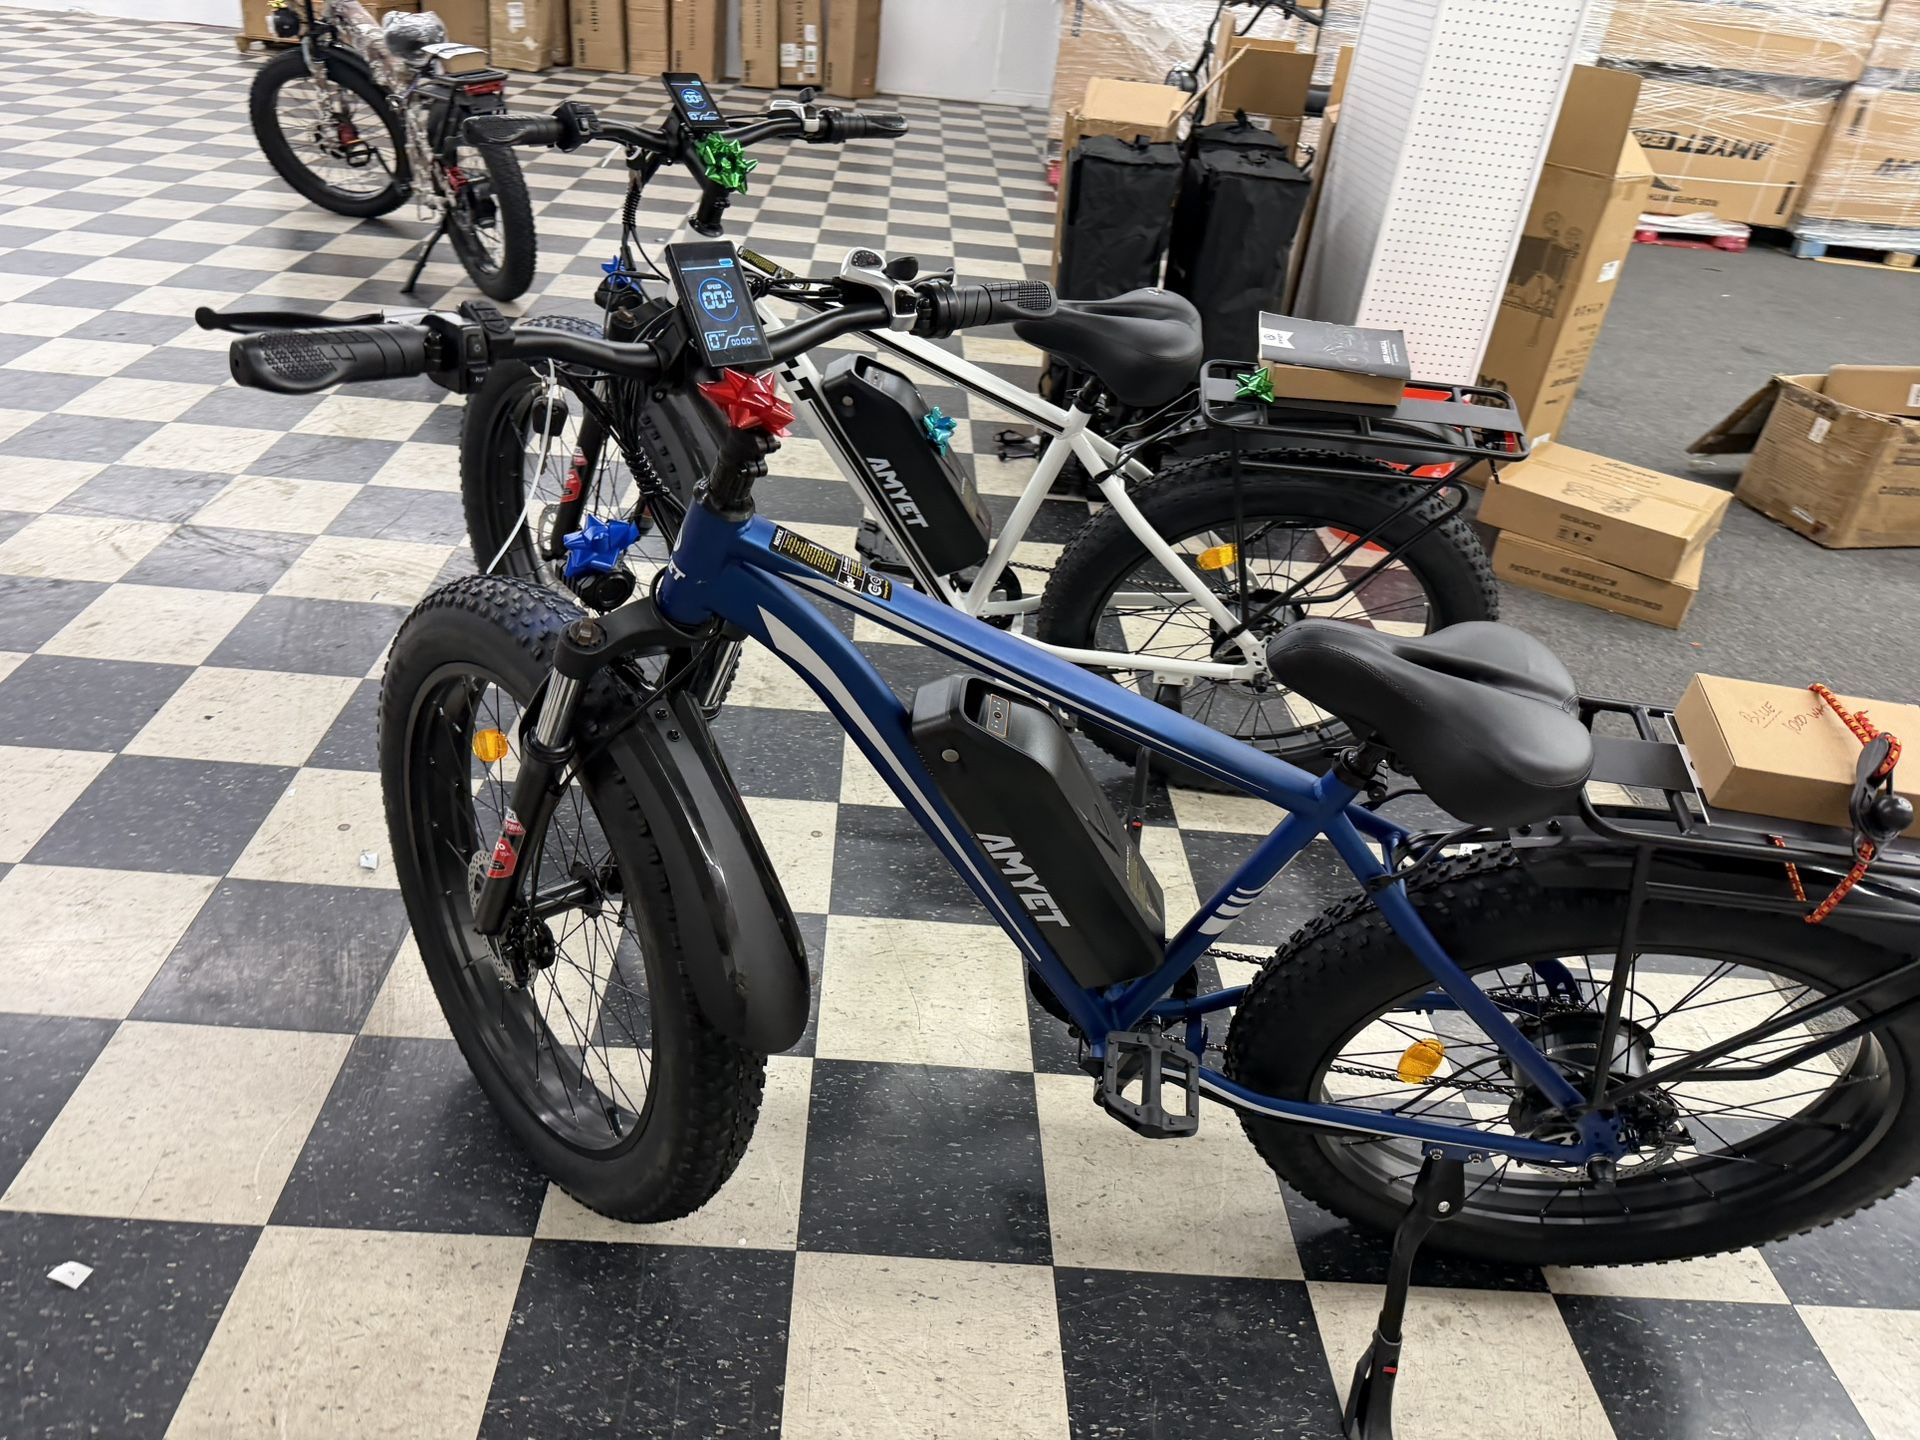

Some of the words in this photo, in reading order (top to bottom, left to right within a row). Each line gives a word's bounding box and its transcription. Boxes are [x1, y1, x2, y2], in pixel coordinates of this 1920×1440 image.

[865, 457, 929, 528] AMYET
[1739, 701, 1776, 725] BLUE
[975, 833, 1072, 927] AMYET
